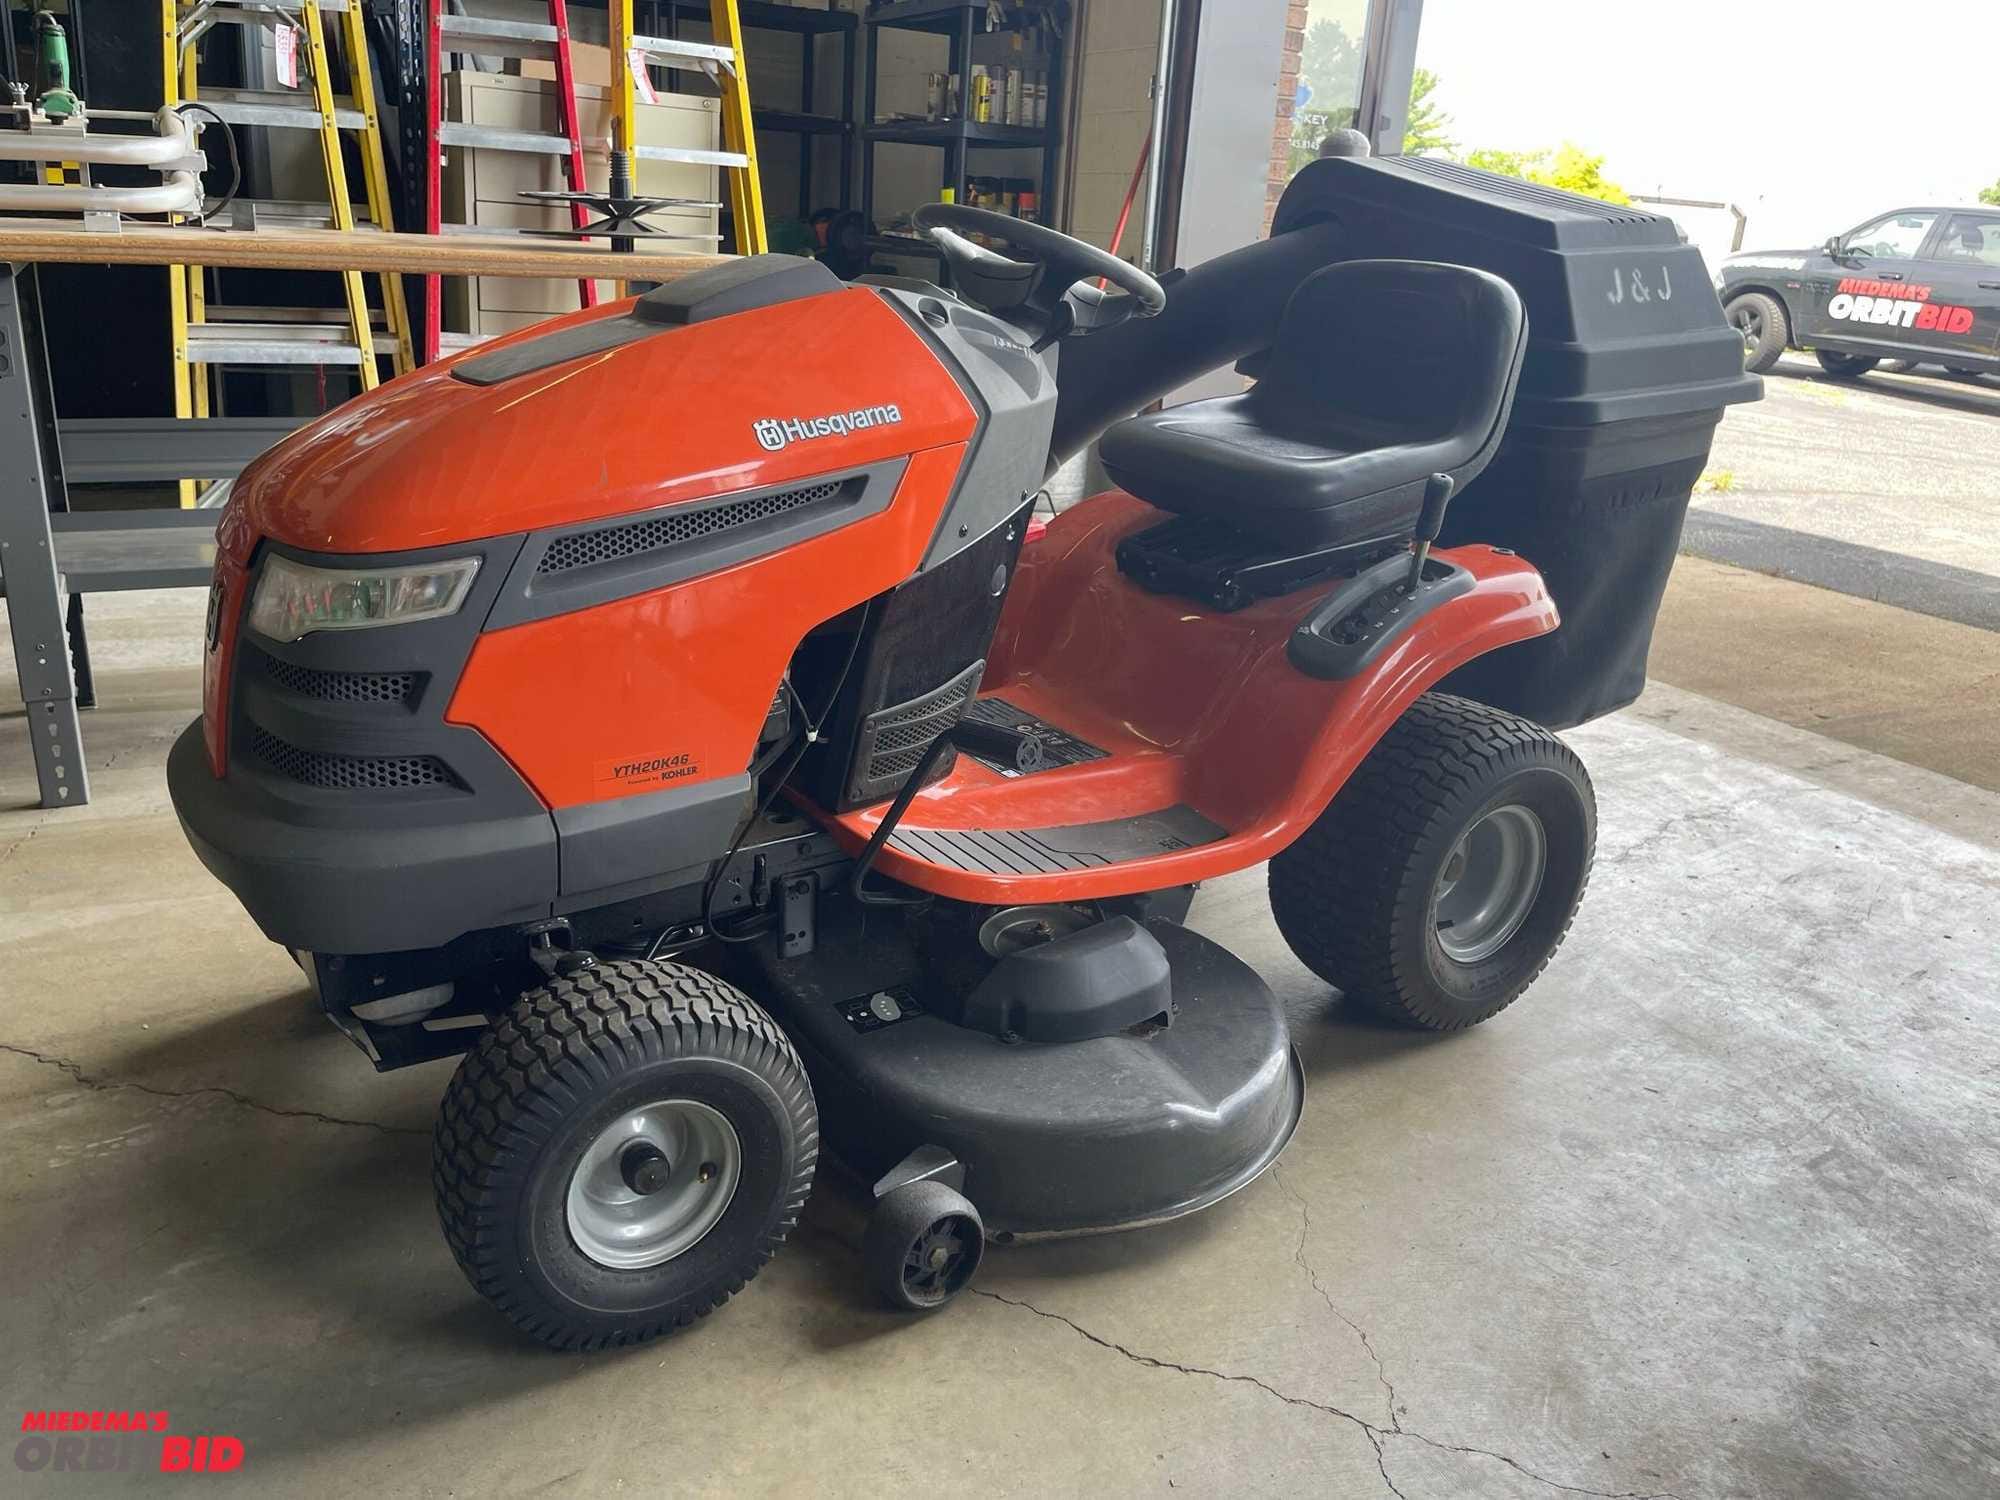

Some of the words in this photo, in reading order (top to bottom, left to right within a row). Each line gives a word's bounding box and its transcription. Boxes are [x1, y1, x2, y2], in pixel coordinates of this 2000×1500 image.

[1606, 266, 1624, 304] J
[1631, 267, 1652, 303] &
[1656, 265, 1673, 301] J
[1838, 278, 1932, 301] MIEDEMA'S
[1828, 293, 1974, 334] ORBITBID
[781, 403, 902, 443] Husqvarna
[613, 753, 690, 778] YTH20K46
[661, 765, 698, 781] KOHLER
